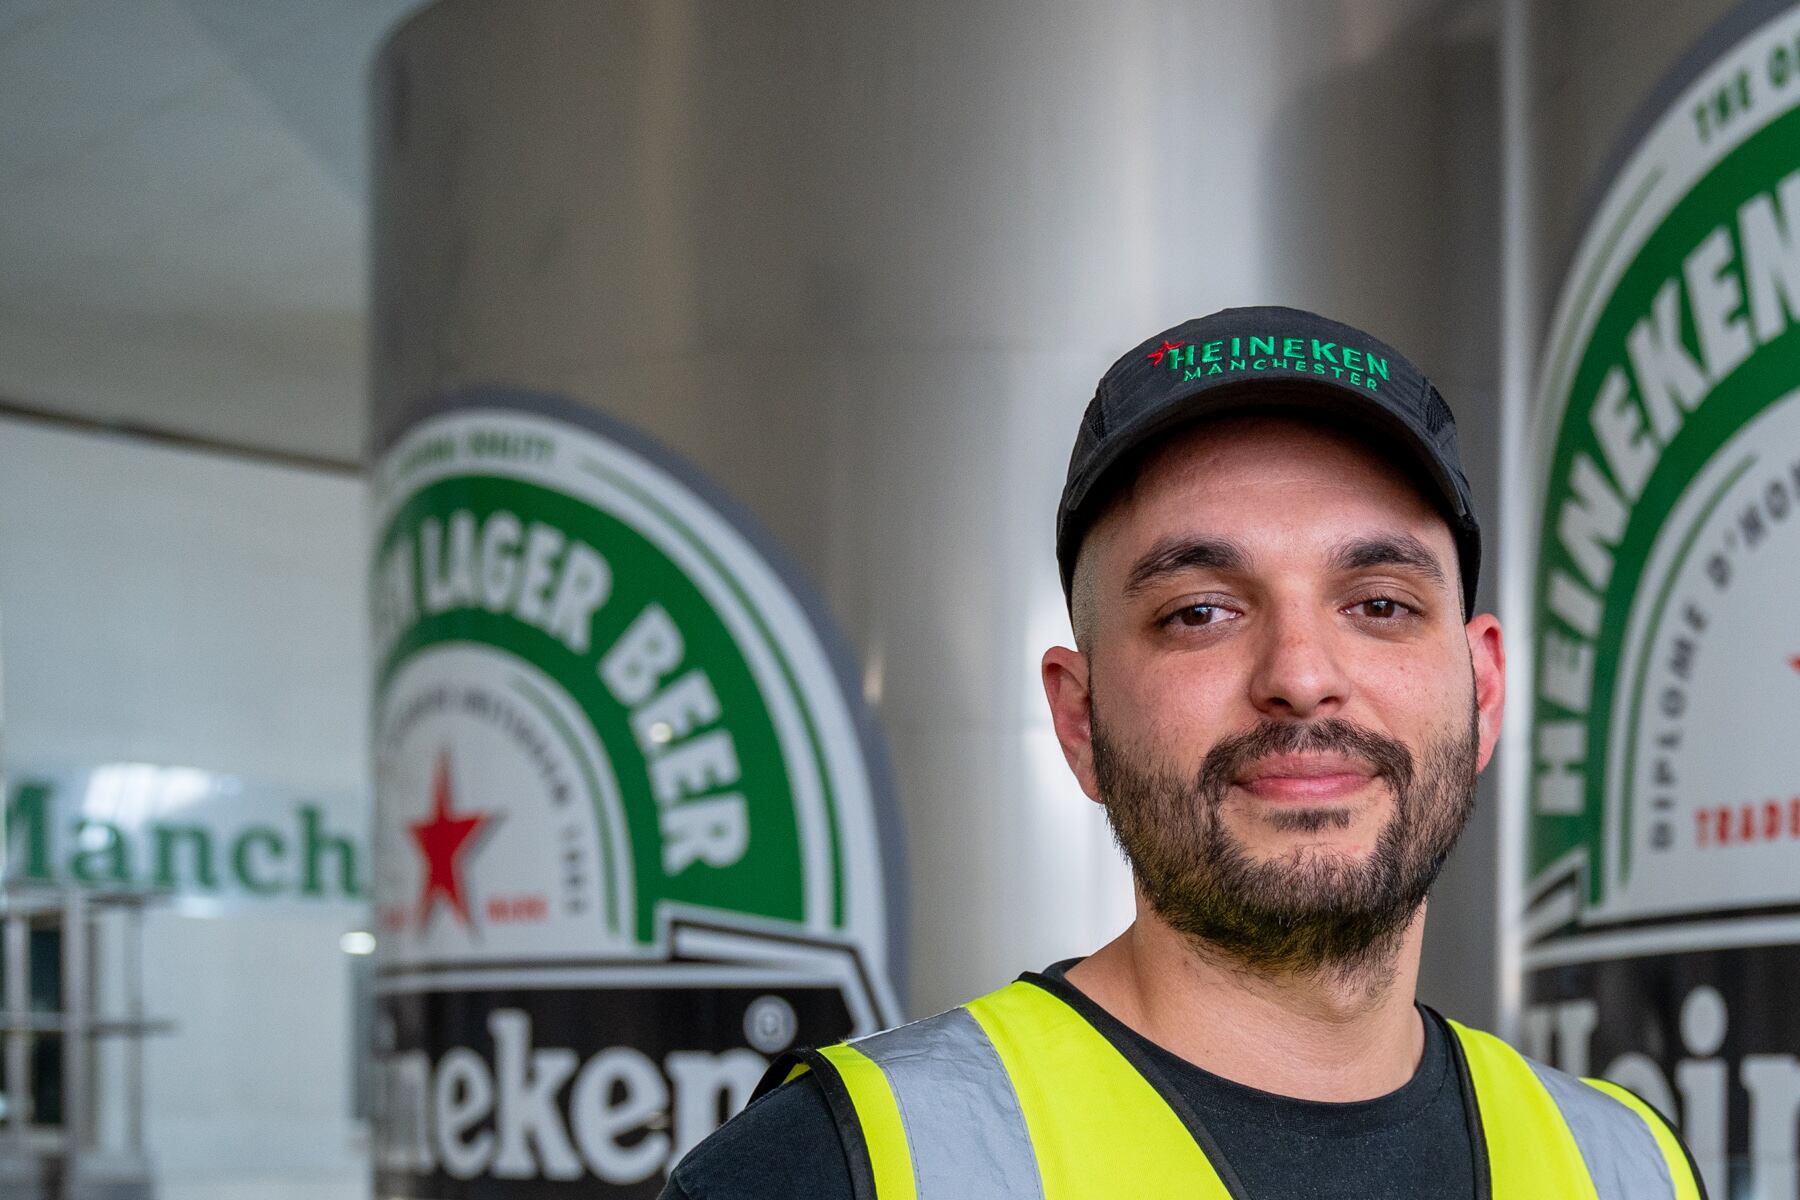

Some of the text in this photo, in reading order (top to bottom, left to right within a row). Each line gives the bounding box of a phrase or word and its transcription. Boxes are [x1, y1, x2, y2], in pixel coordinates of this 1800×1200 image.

[1168, 335, 1390, 382] HEINEKEN
[1183, 357, 1378, 393] MANCHESTER
[419, 509, 614, 656] LAGER
[598, 601, 751, 877] BEER
[1650, 603, 1711, 852] DIPLOME
